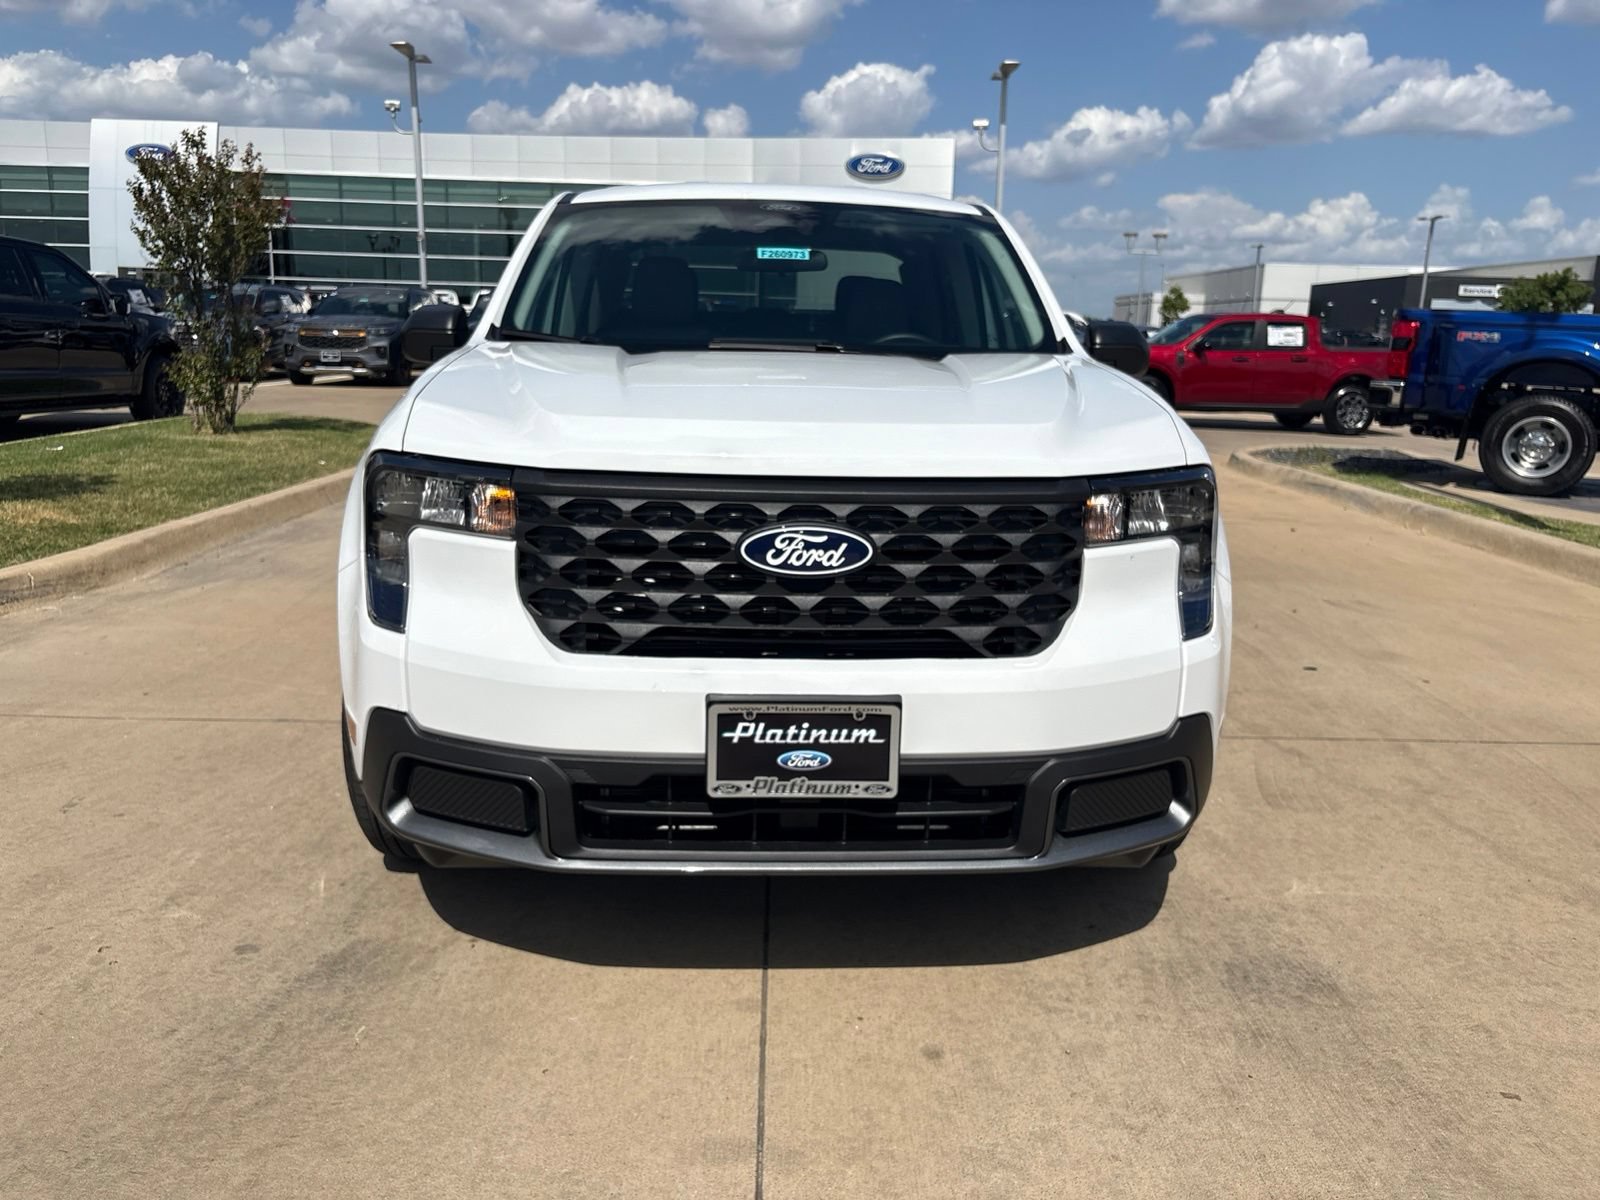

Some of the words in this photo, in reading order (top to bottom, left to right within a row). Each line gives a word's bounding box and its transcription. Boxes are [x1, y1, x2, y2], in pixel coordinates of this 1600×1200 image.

[856, 157, 893, 173] Ford
[760, 249, 806, 259] F260973
[766, 532, 848, 567] Ford
[722, 722, 886, 744] Platinum
[787, 753, 821, 768] Ford
[751, 778, 859, 796] Platinum
